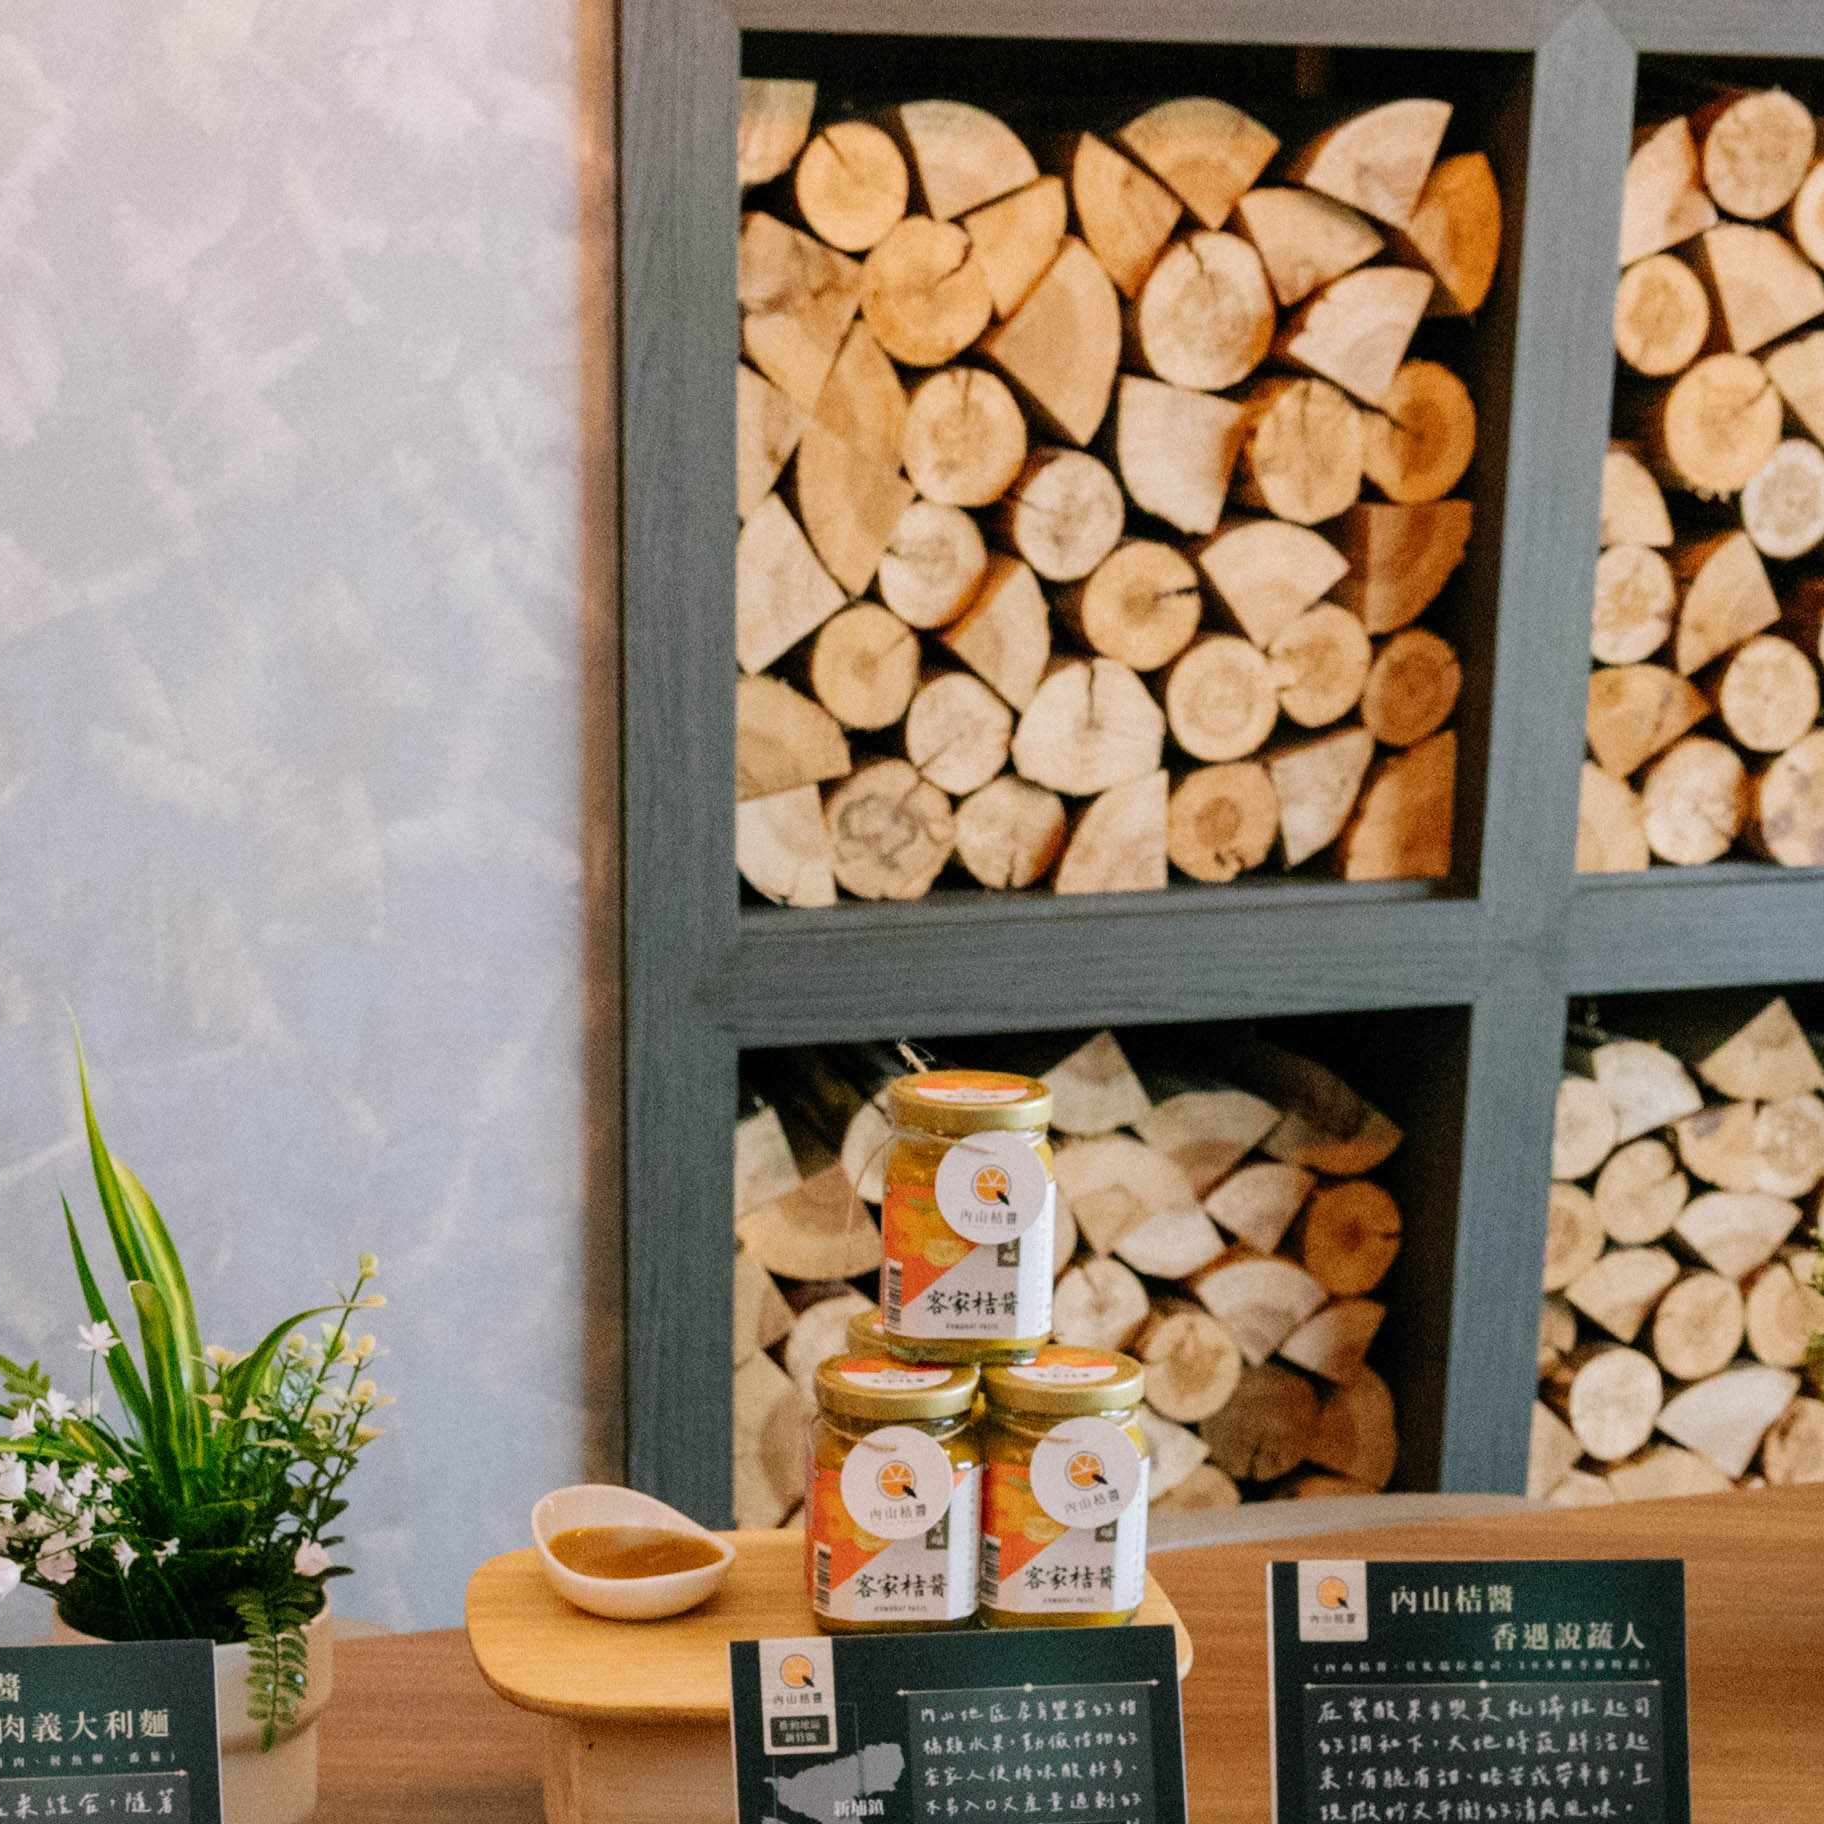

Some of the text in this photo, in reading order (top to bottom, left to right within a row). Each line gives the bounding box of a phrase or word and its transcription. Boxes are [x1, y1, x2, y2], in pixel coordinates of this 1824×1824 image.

[1391, 1585, 1514, 1614] 內山桔醬
[1492, 1622, 1645, 1651] 香遇說蔬人
